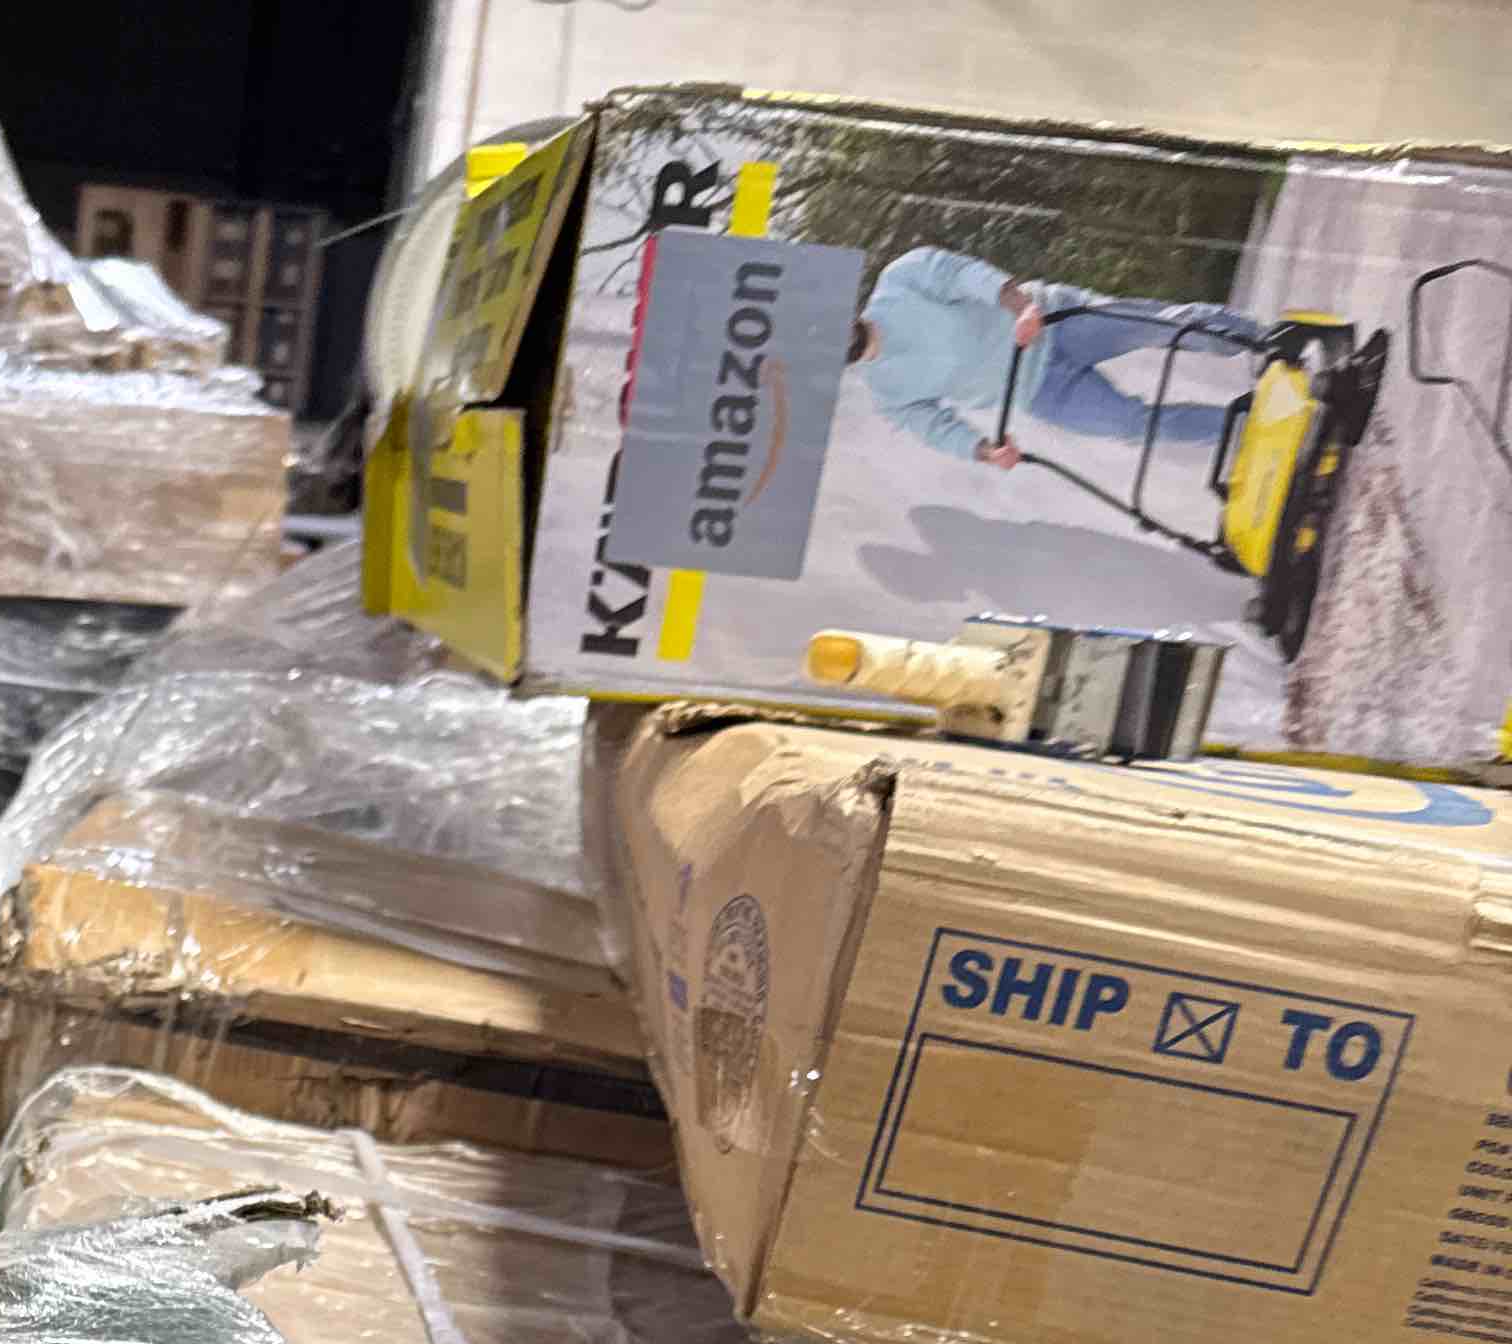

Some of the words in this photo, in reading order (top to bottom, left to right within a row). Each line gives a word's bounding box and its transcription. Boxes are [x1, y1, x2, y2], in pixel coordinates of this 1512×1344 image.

[691, 260, 785, 548] amazon
[941, 947, 1130, 1033] SHIP
[1281, 1008, 1382, 1081] TO
